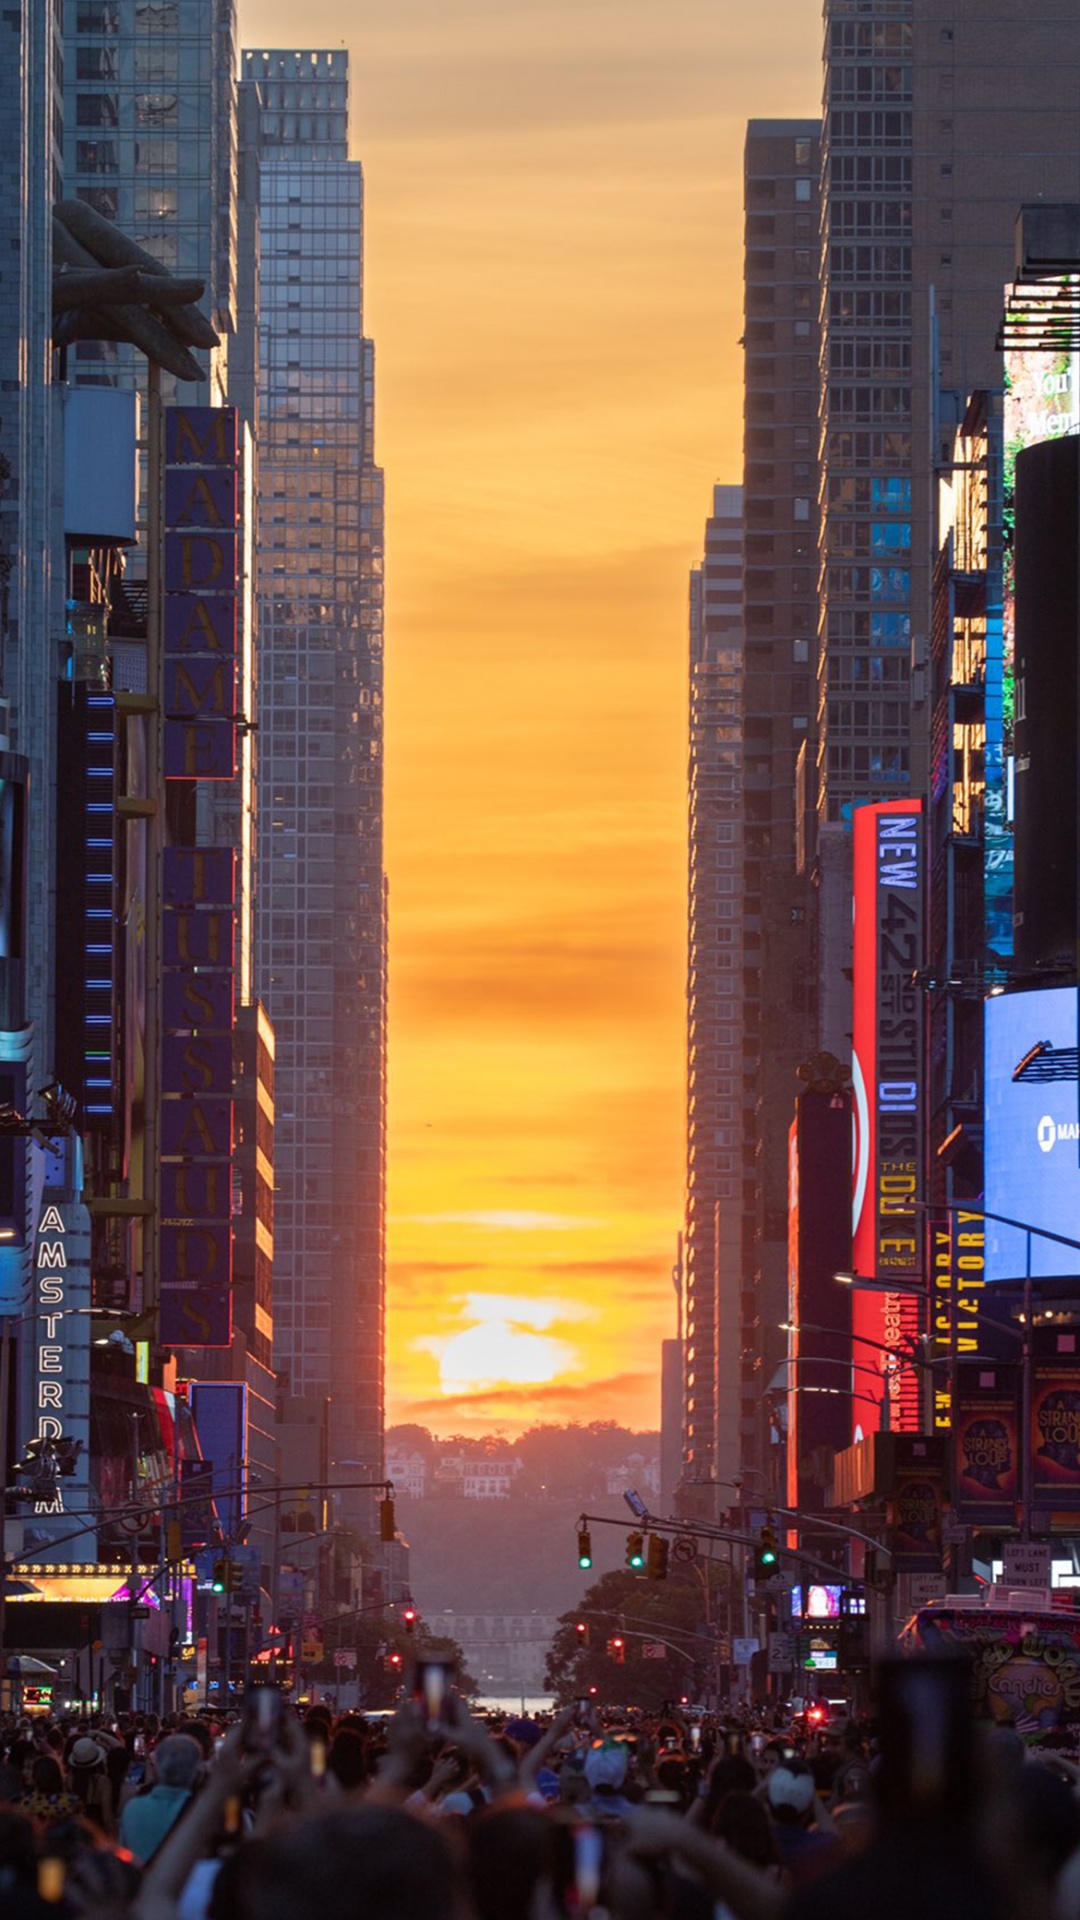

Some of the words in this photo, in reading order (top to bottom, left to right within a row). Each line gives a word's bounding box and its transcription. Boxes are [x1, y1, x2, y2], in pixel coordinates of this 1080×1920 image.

[170, 409, 230, 776] MADAME
[878, 816, 918, 889] NEW
[878, 1018, 918, 1158] STUDIOS
[880, 1161, 916, 1173] THE
[879, 1174, 917, 1254] DUKE
[957, 1210, 985, 1352] VICTORY
[33, 1205, 67, 1515] AMSTERDM
[1056, 1400, 1065, 1411] A
[980, 1428, 987, 1438] A
[969, 1449, 1008, 1471] LOOP
[1006, 1549, 1025, 1558] LEFT
[1028, 1549, 1048, 1558] LANE
[1014, 1563, 1040, 1572] MUST
[987, 1673, 1064, 1699] Candies
